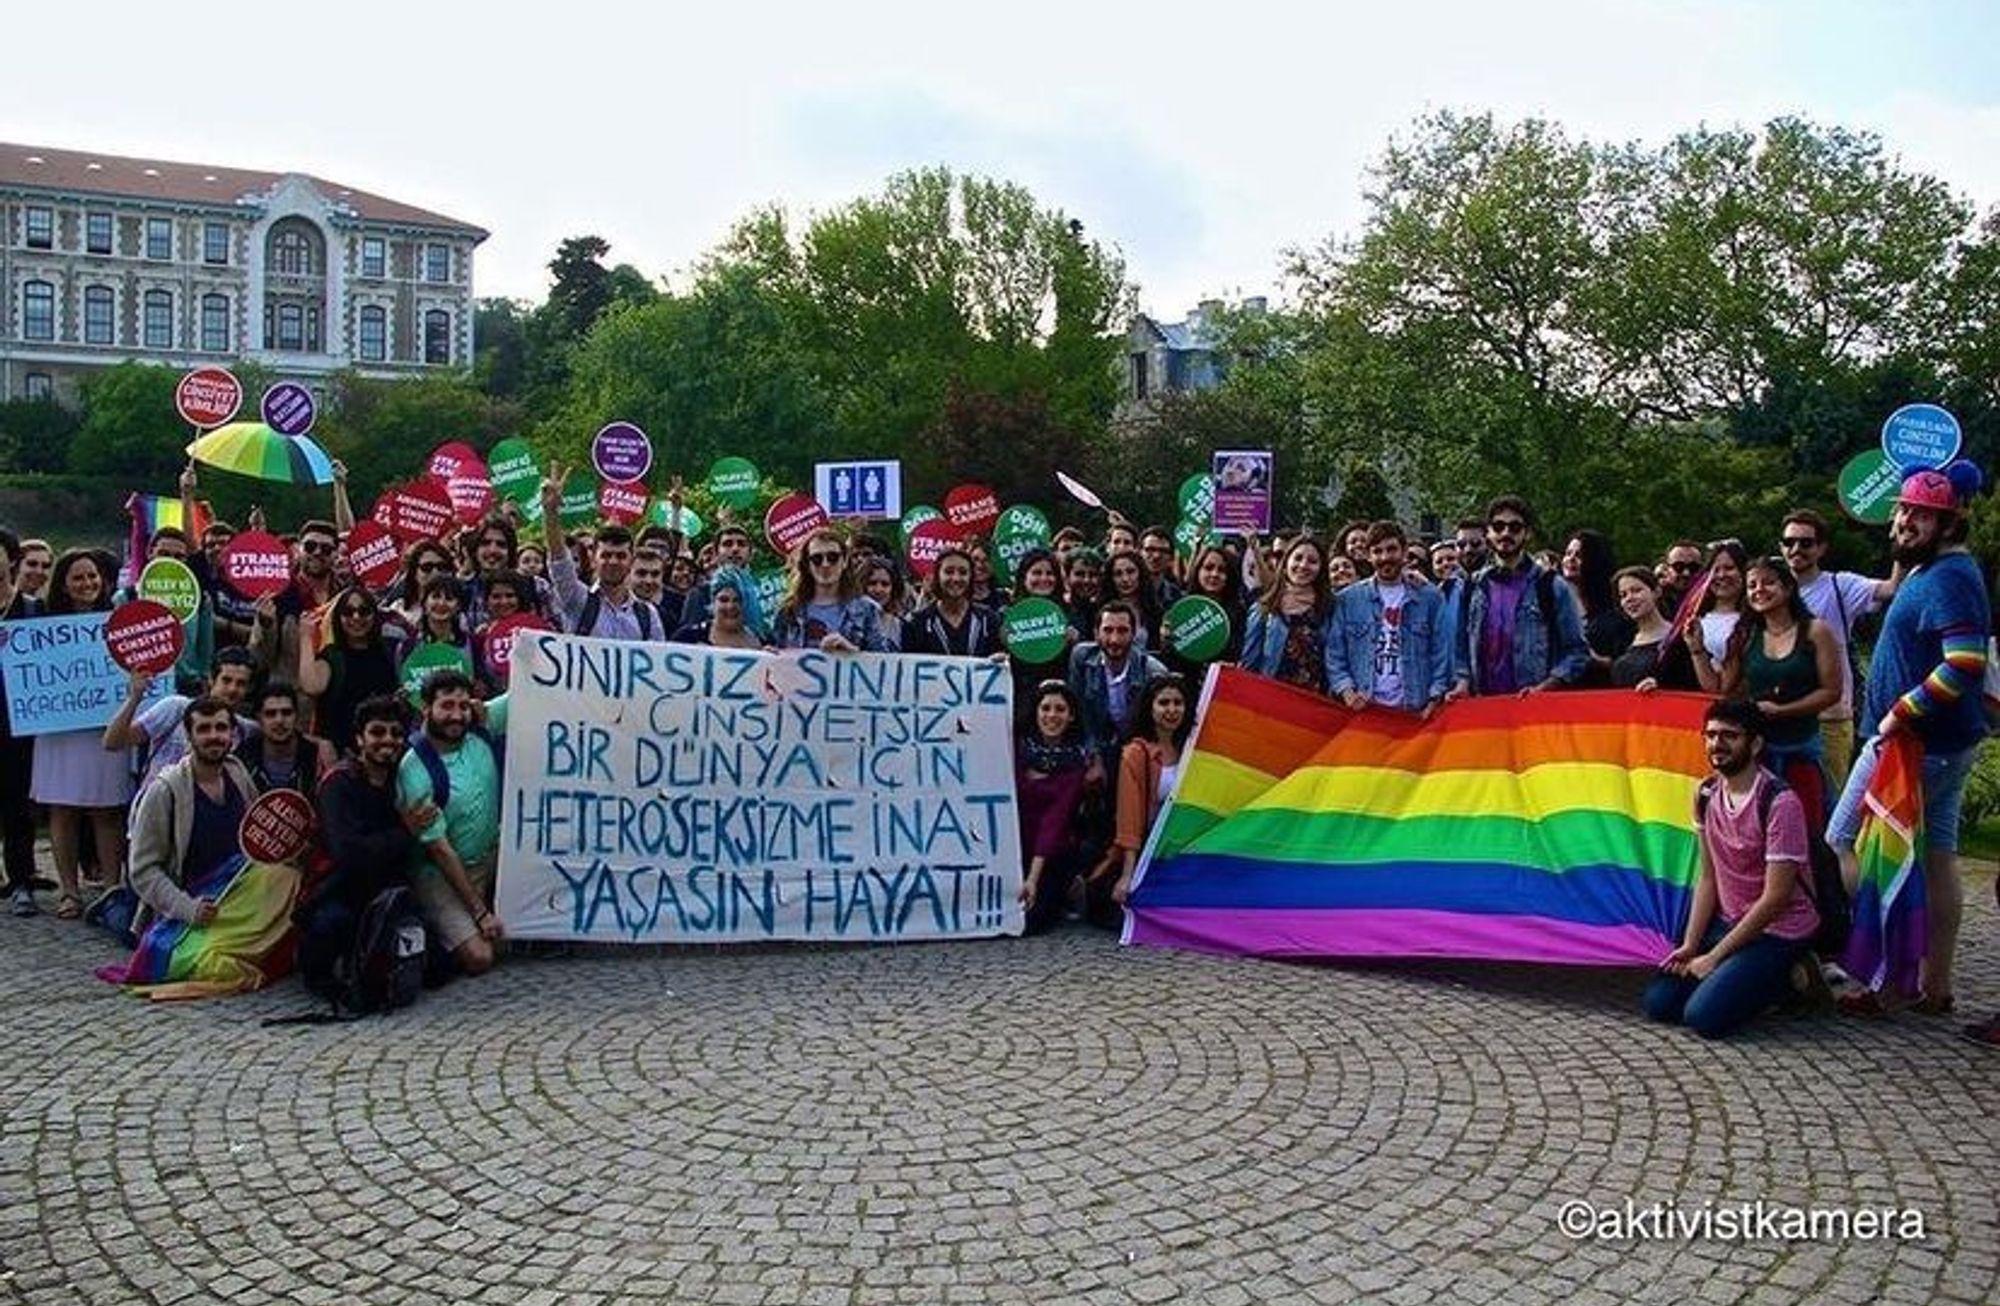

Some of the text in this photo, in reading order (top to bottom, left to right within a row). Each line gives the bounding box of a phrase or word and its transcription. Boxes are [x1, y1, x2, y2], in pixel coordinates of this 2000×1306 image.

[230, 552, 289, 566] #TRANS
[531, 636, 759, 700] SINIRSIZ
[795, 653, 1007, 707] SINIFSIZ
[546, 720, 967, 792] BİR DÜNYA İÇİN
[517, 787, 1011, 866] HETEROSEKSİZME İNAT
[552, 858, 774, 940] YAŞASIN
